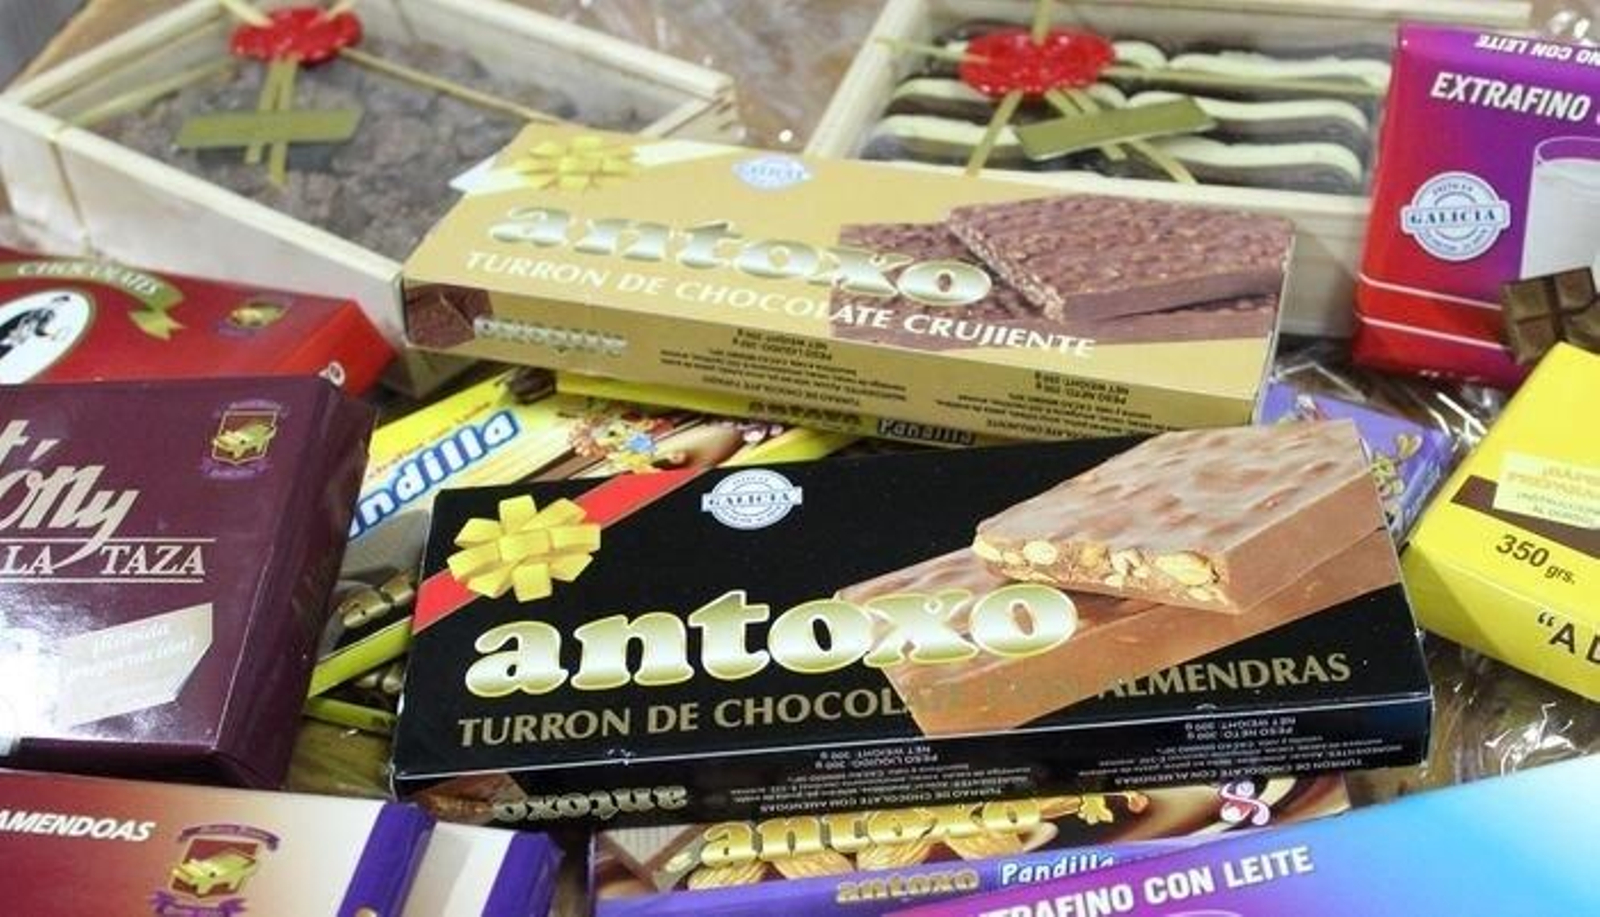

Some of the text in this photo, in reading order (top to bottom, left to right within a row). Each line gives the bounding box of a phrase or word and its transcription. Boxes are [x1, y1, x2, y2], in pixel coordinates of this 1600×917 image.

[1530, 42, 1573, 61] CON
[1430, 72, 1591, 122] EXTRAFINO
[1410, 209, 1496, 225] GALICIA
[488, 205, 992, 306] antoxo
[464, 249, 1096, 360] TURRON DE CHOCOLATE CRUJIENTE
[348, 410, 521, 538] ndilla
[0, 545, 206, 576] LA TAZA
[1495, 533, 1577, 585] 350 grs.
[464, 588, 1079, 698] antoxo
[457, 707, 632, 748] TURRON
[647, 702, 701, 734] DE
[1096, 650, 1353, 699] ALMENDRAS
[0, 810, 156, 842] AMENDOAS
[700, 797, 1041, 867] antoxo
[837, 870, 981, 903] antoxo
[1143, 864, 1215, 906] CON
[1224, 846, 1315, 888] LEITE
